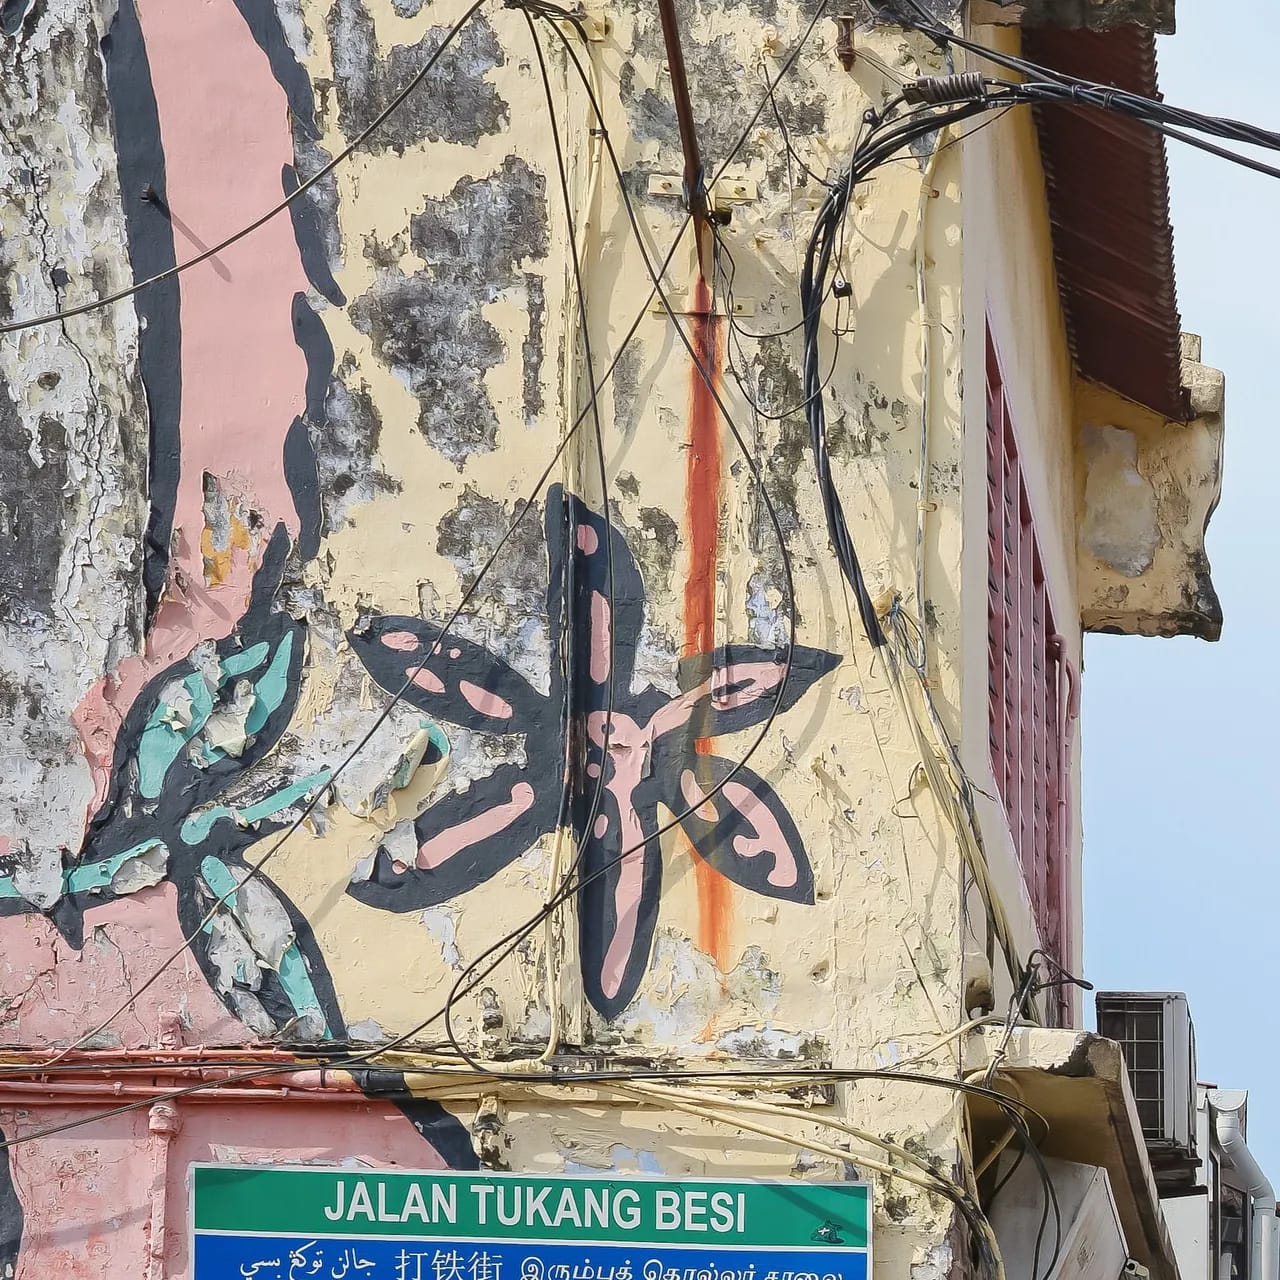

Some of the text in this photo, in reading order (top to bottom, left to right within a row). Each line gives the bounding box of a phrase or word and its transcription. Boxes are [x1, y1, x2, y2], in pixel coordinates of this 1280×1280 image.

[324, 1181, 746, 1234] JALAN TUKANG BESI
